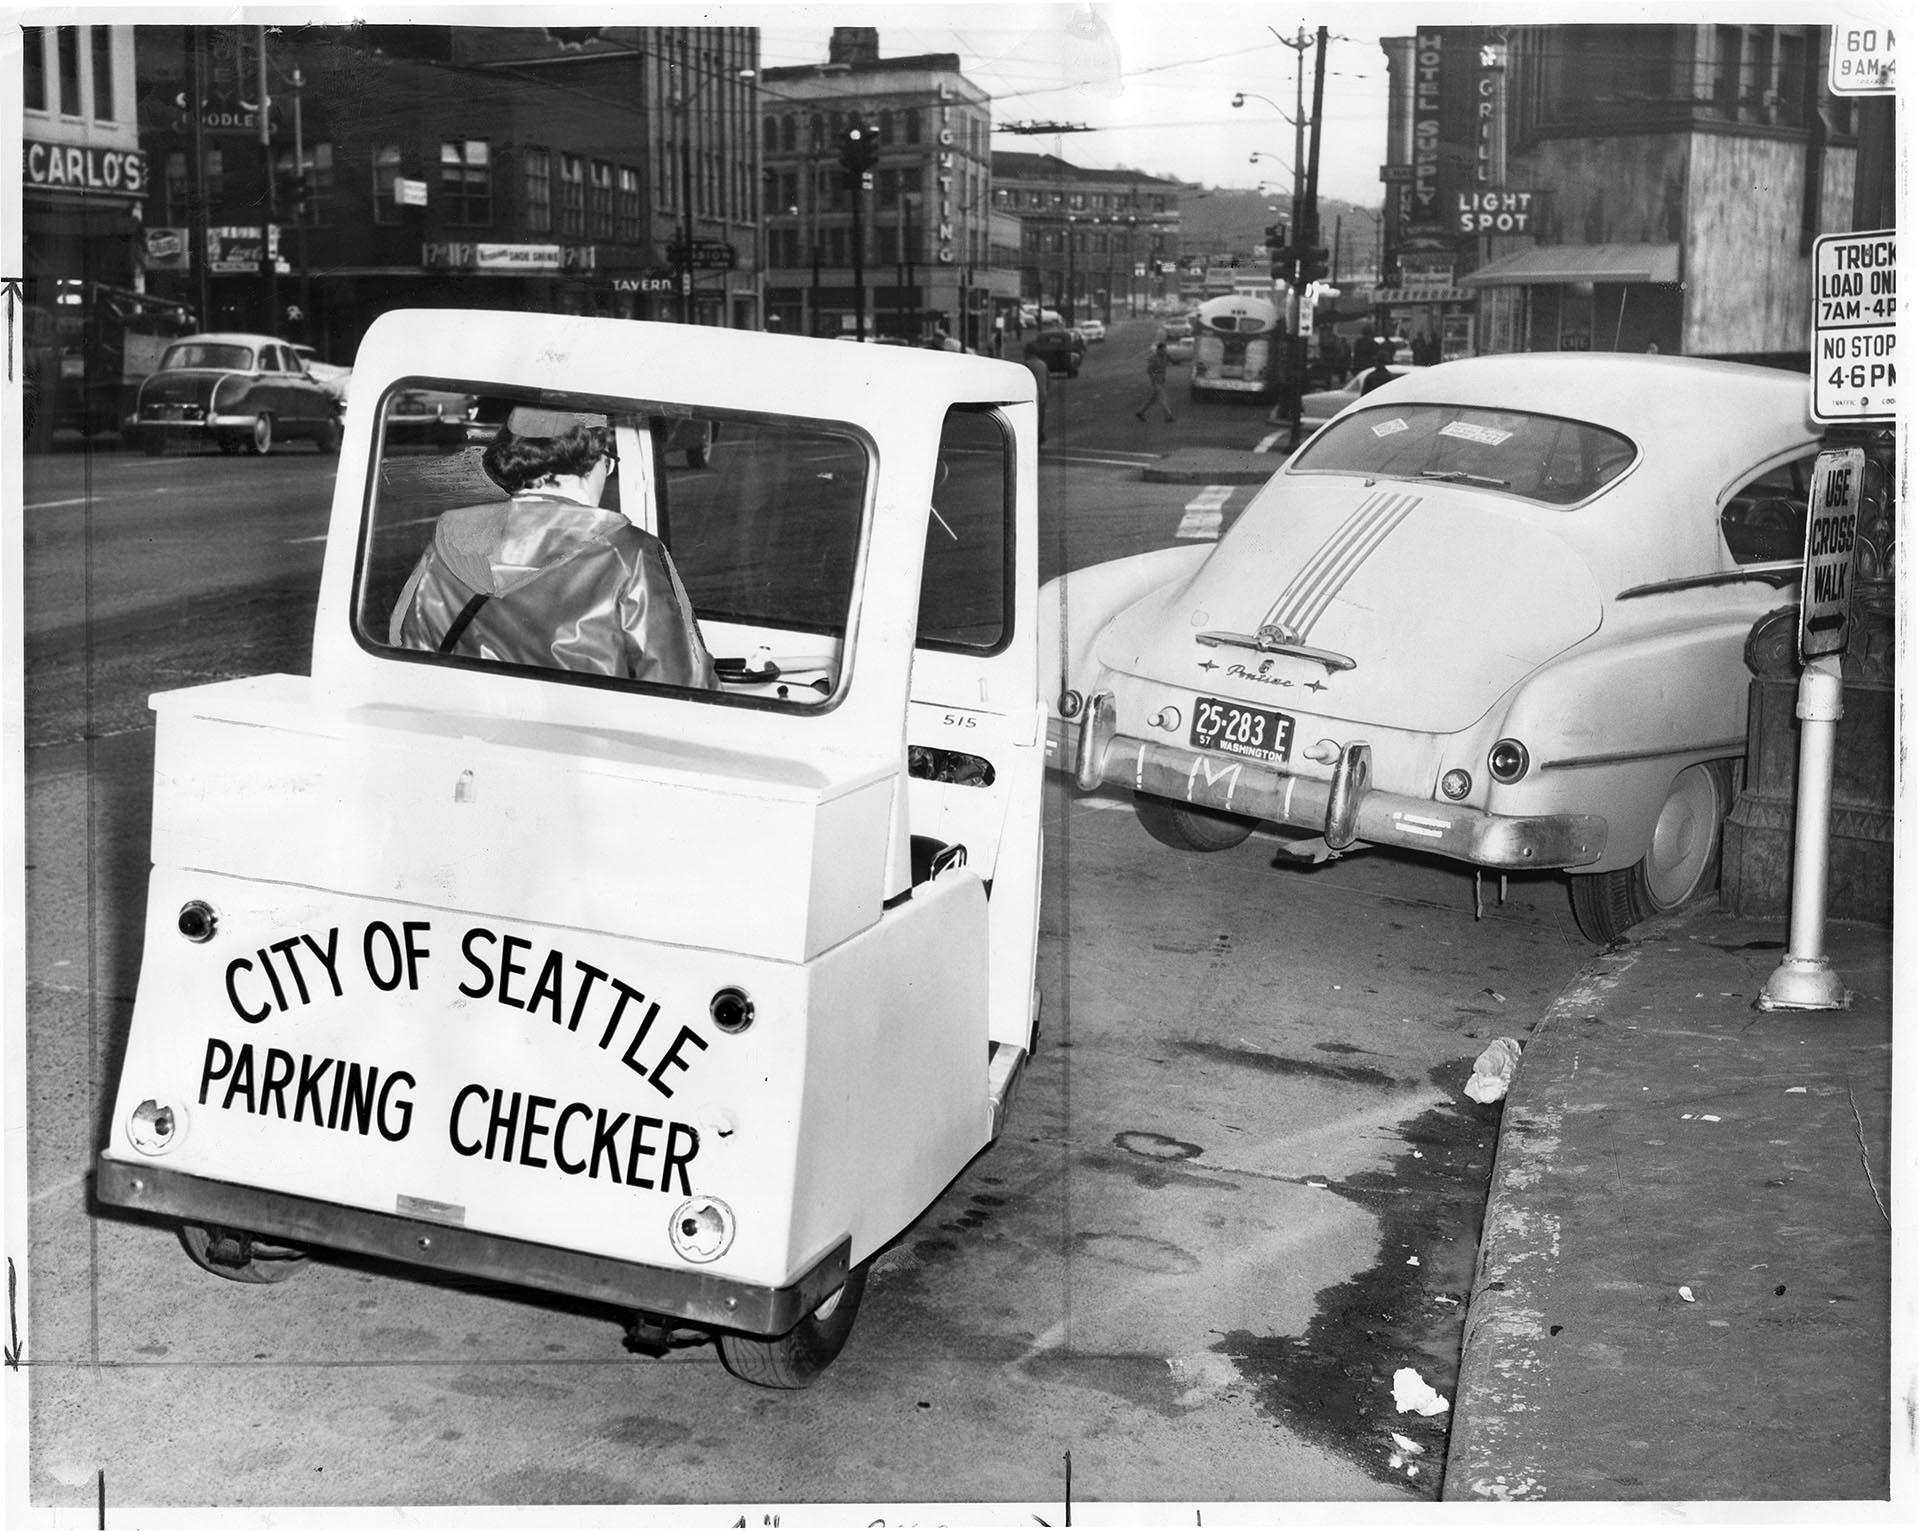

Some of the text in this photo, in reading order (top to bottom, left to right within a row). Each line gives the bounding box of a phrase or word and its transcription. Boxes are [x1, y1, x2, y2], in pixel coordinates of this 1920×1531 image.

[1847, 30, 1877, 52] 60
[1418, 34, 1442, 111] HOTEL
[182, 112, 255, 128] ODLE
[1478, 79, 1494, 182] GRILL
[28, 143, 141, 191] CARLO'S
[1416, 119, 1440, 206] SUPPLY
[1458, 192, 1531, 212] LIGHT
[1459, 213, 1528, 232] SPOT
[612, 280, 672, 292] TAVERN
[1822, 272, 1863, 298] LOAD
[1823, 337, 1846, 359] NO
[1825, 469, 1851, 508] USE
[1811, 514, 1855, 556] CROSS
[1814, 562, 1848, 603] WALK
[1226, 664, 1294, 687] Pontiac
[943, 714, 977, 728] 515
[1196, 703, 1290, 752] 25-283 E
[1199, 734, 1283, 762] 57 WASHINGTON
[225, 921, 709, 1098] CITY OF SEATTLE
[198, 1037, 700, 1197] PARKING CHECKER
